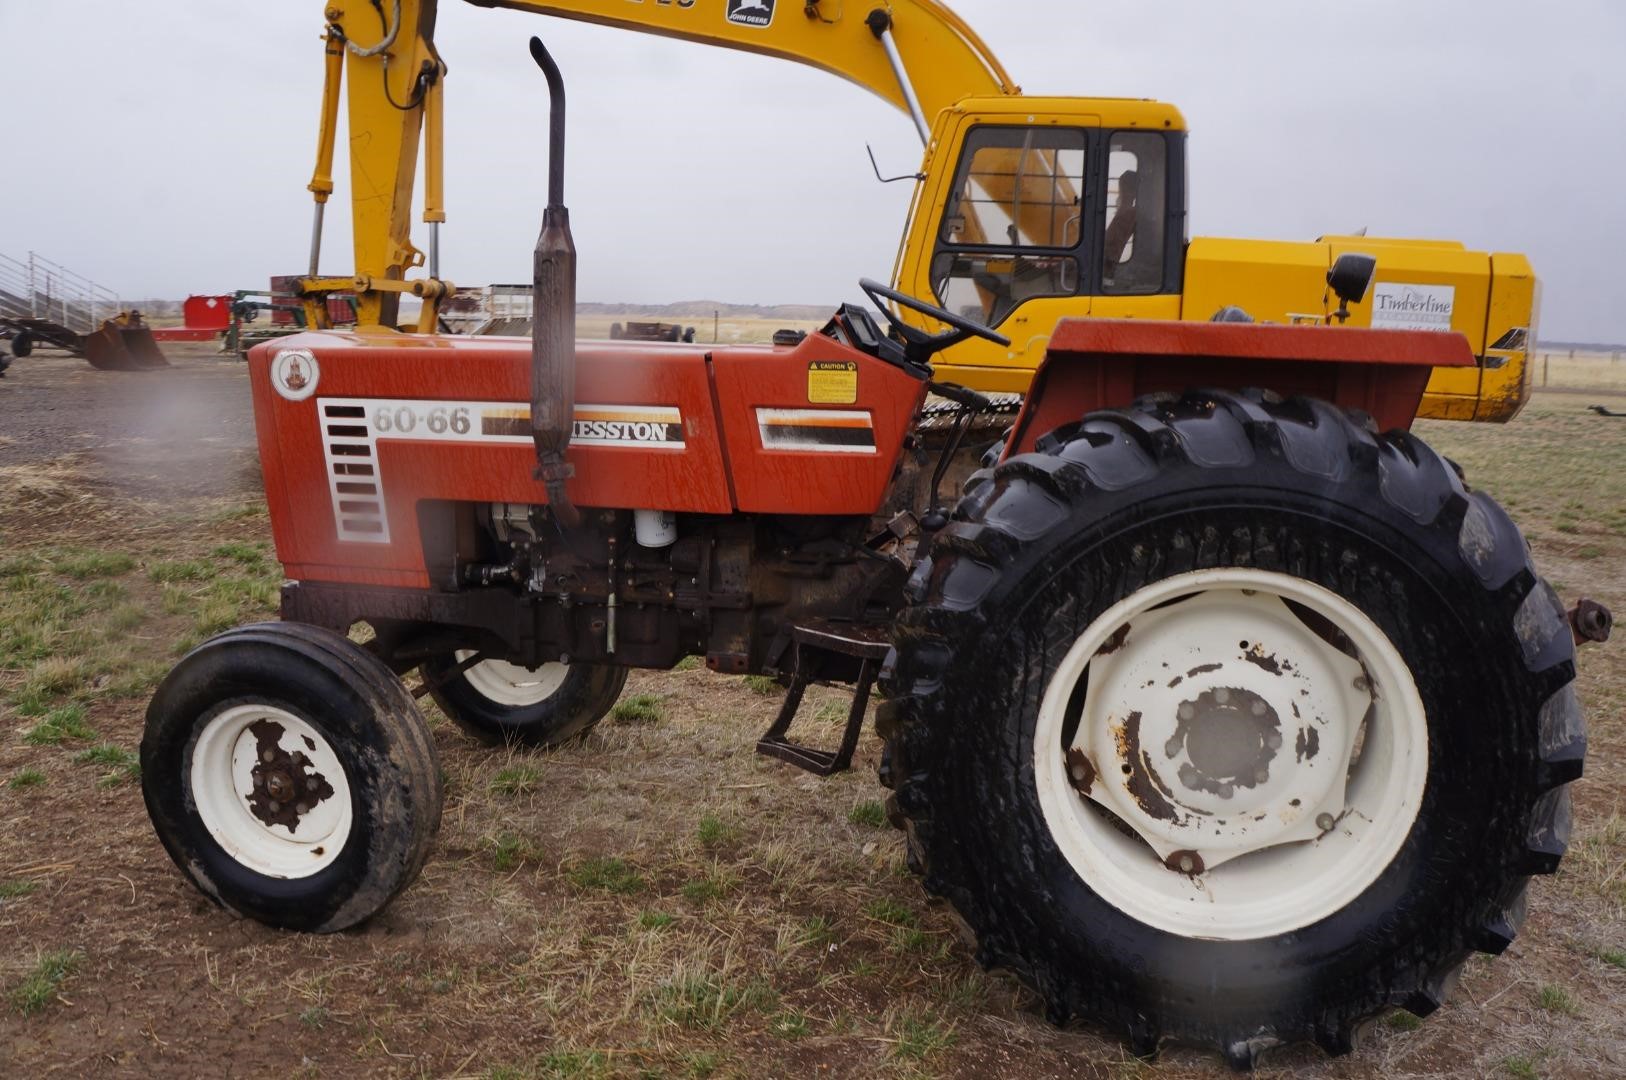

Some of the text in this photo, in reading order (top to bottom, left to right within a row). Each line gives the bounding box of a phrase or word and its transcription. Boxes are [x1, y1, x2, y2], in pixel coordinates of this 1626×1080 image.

[729, 13, 769, 25] JOHN DEERE
[1376, 294, 1450, 313] Timberline
[820, 362, 846, 370] CAUTION
